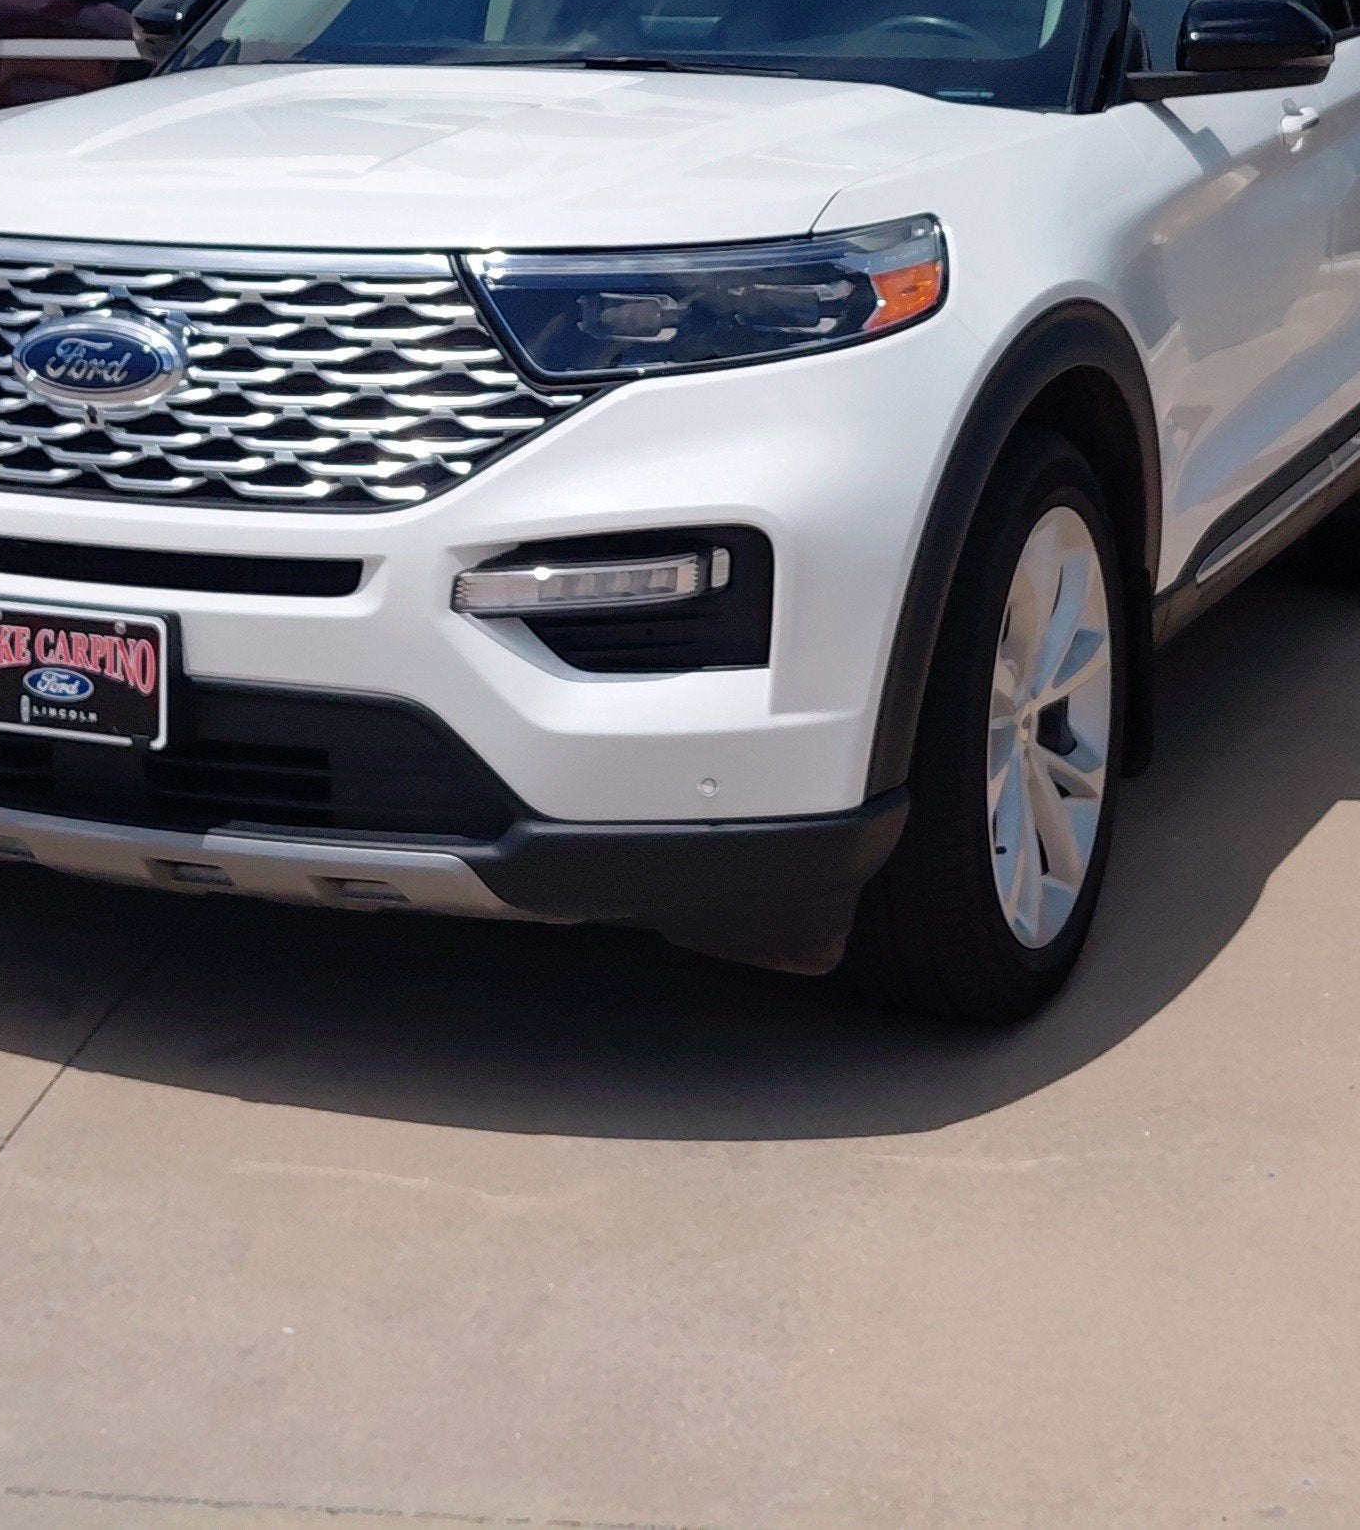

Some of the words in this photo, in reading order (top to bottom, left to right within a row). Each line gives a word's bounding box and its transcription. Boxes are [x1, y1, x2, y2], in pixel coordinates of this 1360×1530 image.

[46, 337, 132, 383] Ford
[34, 628, 155, 695] CARPINO
[37, 671, 80, 695] Ford
[33, 704, 97, 723] LINCOLN
